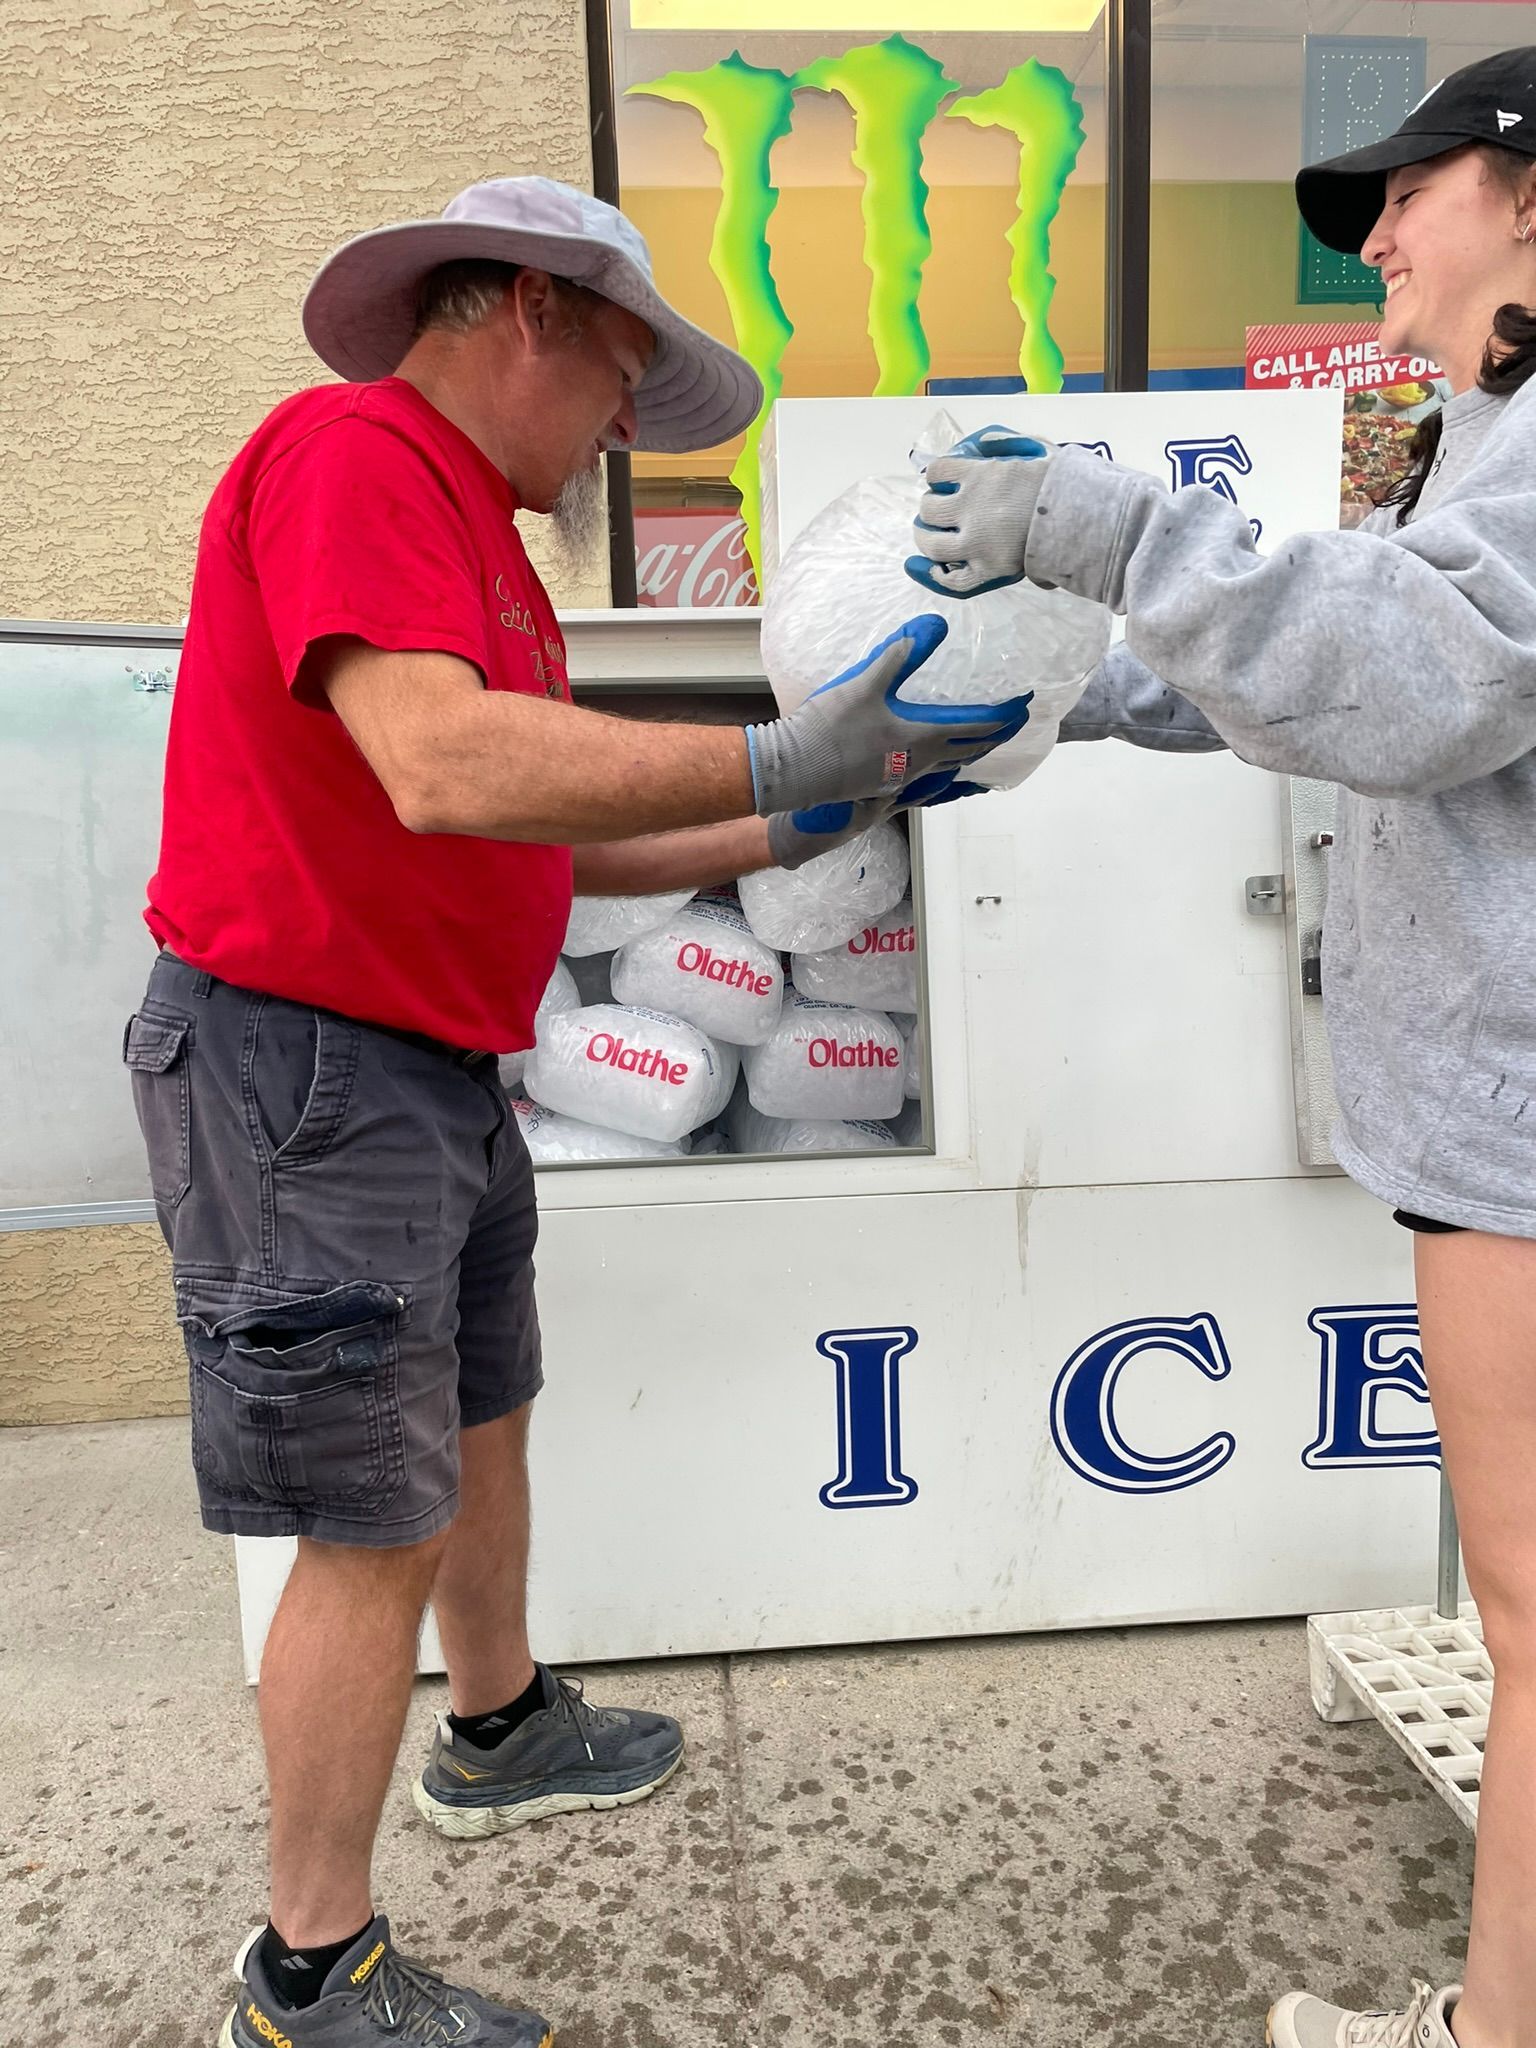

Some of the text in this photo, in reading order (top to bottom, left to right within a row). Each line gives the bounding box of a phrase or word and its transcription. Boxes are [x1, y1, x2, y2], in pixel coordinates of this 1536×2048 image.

[1252, 341, 1389, 380] CALL AHE
[1288, 357, 1442, 389] & CARRY-OU
[677, 942, 773, 997] Olathe
[586, 1032, 689, 1087] Olathe
[808, 1037, 900, 1069] Olathe
[350, 1948, 381, 1984] HOKA
[247, 2003, 293, 2048] HOKA
